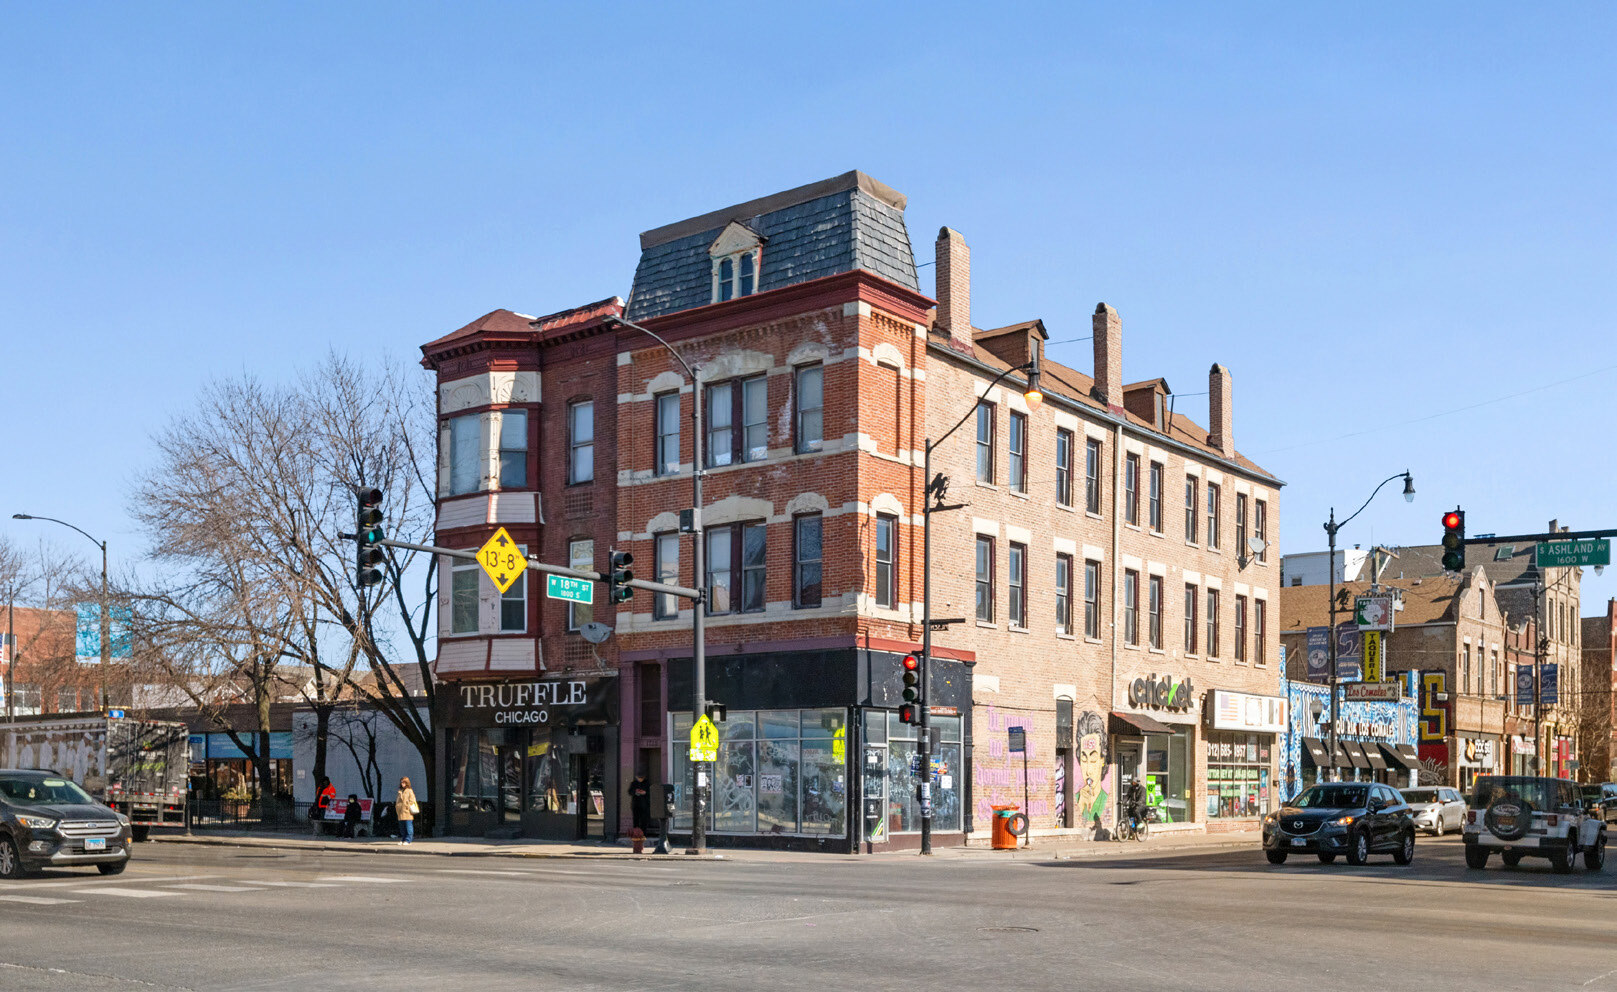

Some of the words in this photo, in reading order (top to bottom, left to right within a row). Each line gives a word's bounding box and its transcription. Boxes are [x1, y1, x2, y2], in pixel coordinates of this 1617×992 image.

[1540, 546, 1545, 555] S
[1548, 543, 1593, 555] ASHLAND
[1597, 543, 1607, 552] AV
[1557, 556, 1577, 564] 1600
[1581, 555, 1589, 563] W
[560, 579, 578, 589] 18TH
[575, 591, 580, 599] S
[1367, 633, 1377, 681] TAQUERIA
[460, 681, 587, 708] TRUFFLE
[1131, 673, 1195, 708] cricket
[495, 710, 548, 723] CHICAGO
